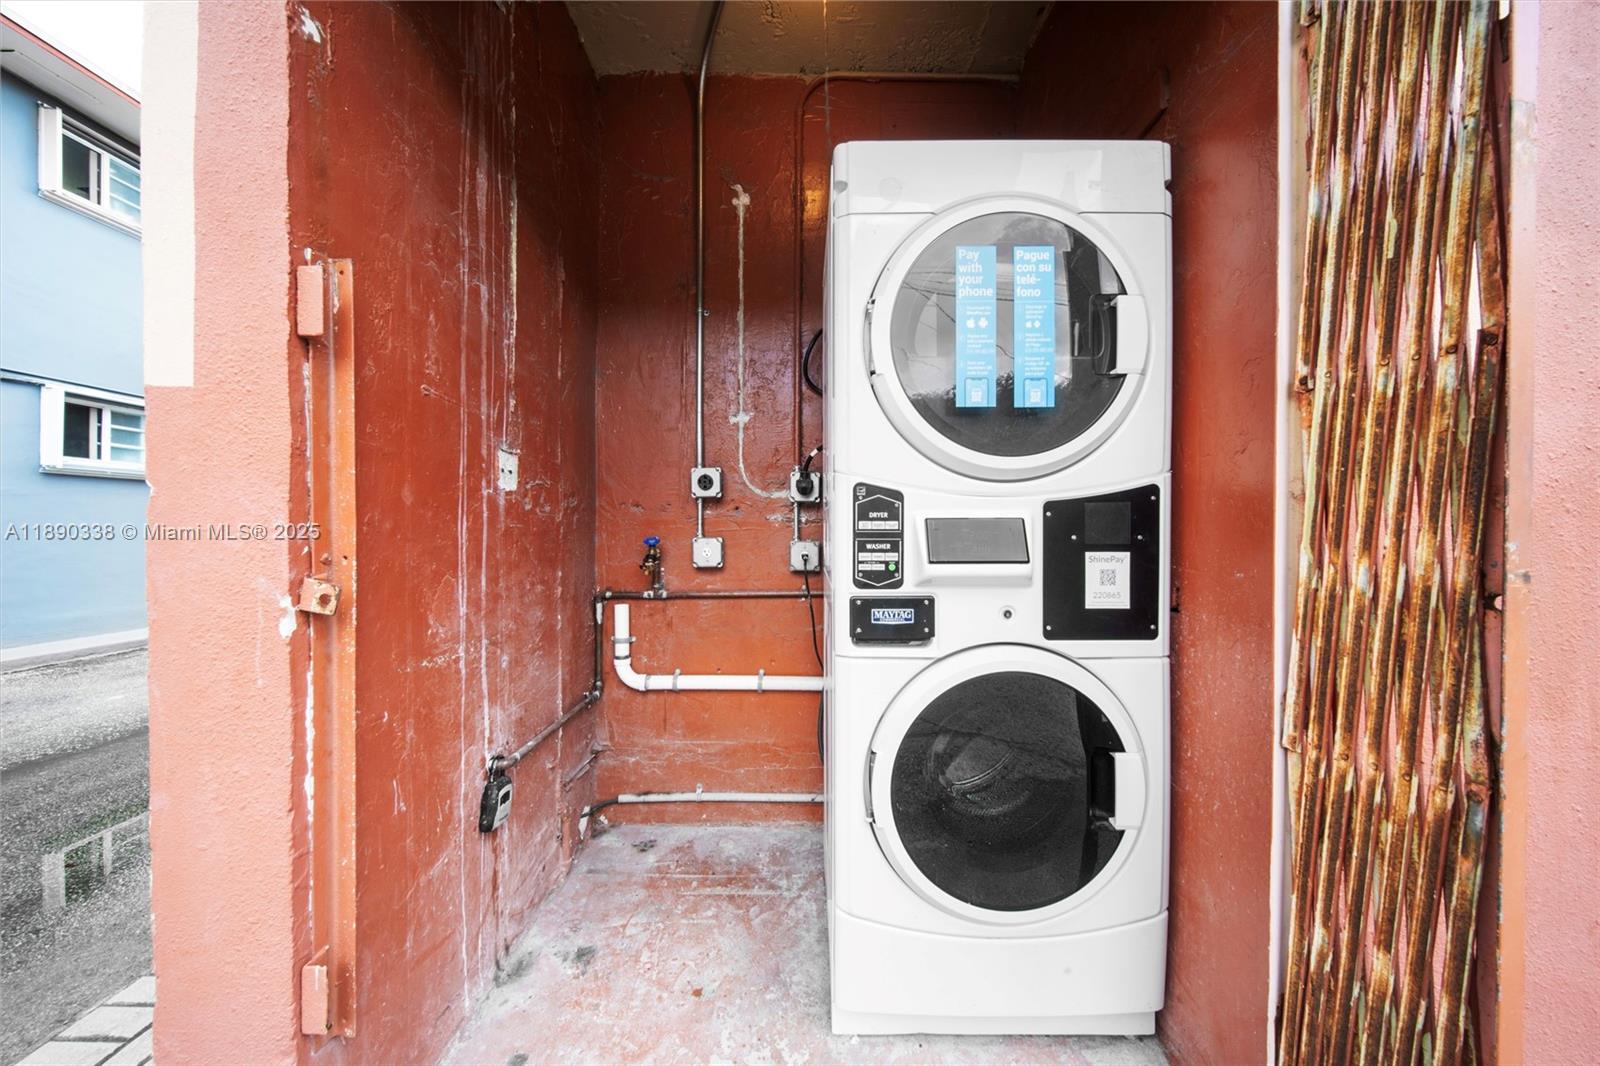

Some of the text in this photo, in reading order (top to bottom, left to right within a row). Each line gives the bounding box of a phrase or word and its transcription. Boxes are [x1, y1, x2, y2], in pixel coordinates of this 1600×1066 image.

[958, 249, 980, 262] Pay
[1016, 250, 1049, 263] Pague
[958, 262, 982, 273] with
[1016, 263, 1051, 272] con su
[958, 275, 984, 286] your
[958, 286, 993, 298] phone
[1016, 286, 1041, 297] fono
[874, 610, 912, 619] MAYTAG
